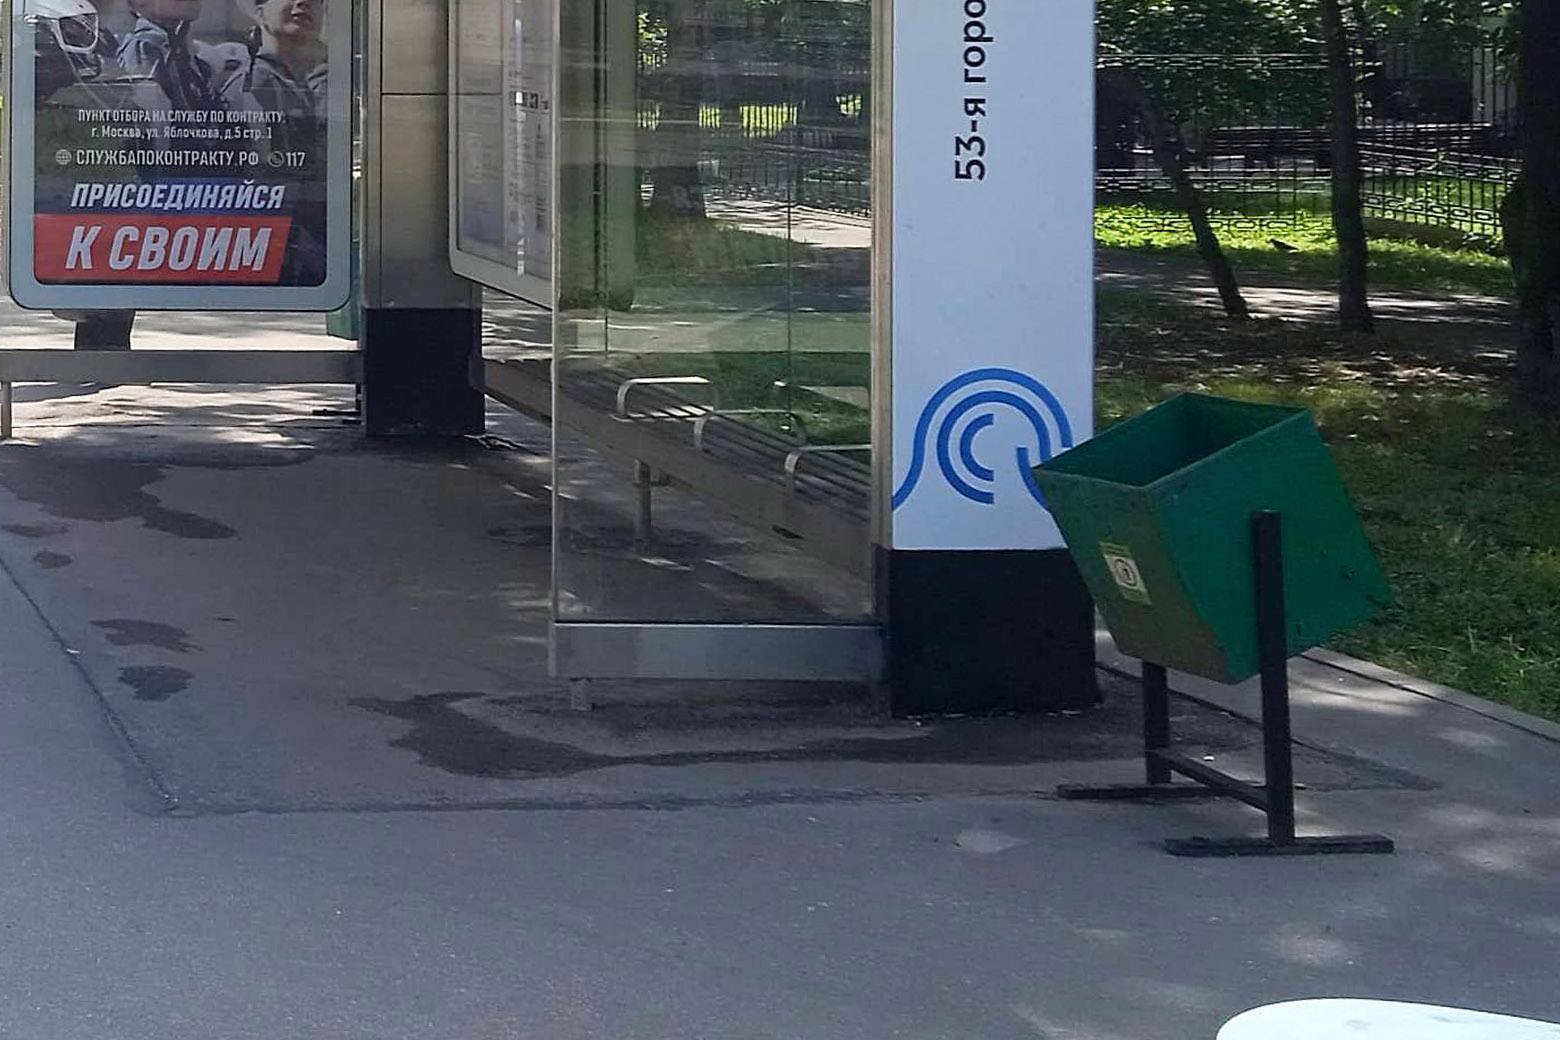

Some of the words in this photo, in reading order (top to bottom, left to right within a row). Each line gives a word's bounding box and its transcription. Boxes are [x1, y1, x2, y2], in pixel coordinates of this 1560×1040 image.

[78, 109, 110, 122] ПУНКТ
[113, 109, 151, 122] ОТБОРА
[152, 109, 166, 122] НА
[168, 110, 209, 122] СЛУЖБУ
[210, 110, 225, 122] ПО
[102, 125, 145, 139] Москва,
[954, 98, 987, 181] 53-я
[76, 149, 259, 166] СЛУЖБАПОКОНТРАКТУ.РФ
[285, 151, 305, 167] 117
[71, 179, 285, 210] ПРИСОЕДИНЯЙСЯ
[65, 225, 102, 270] К
[109, 225, 272, 271] СВОИМ
